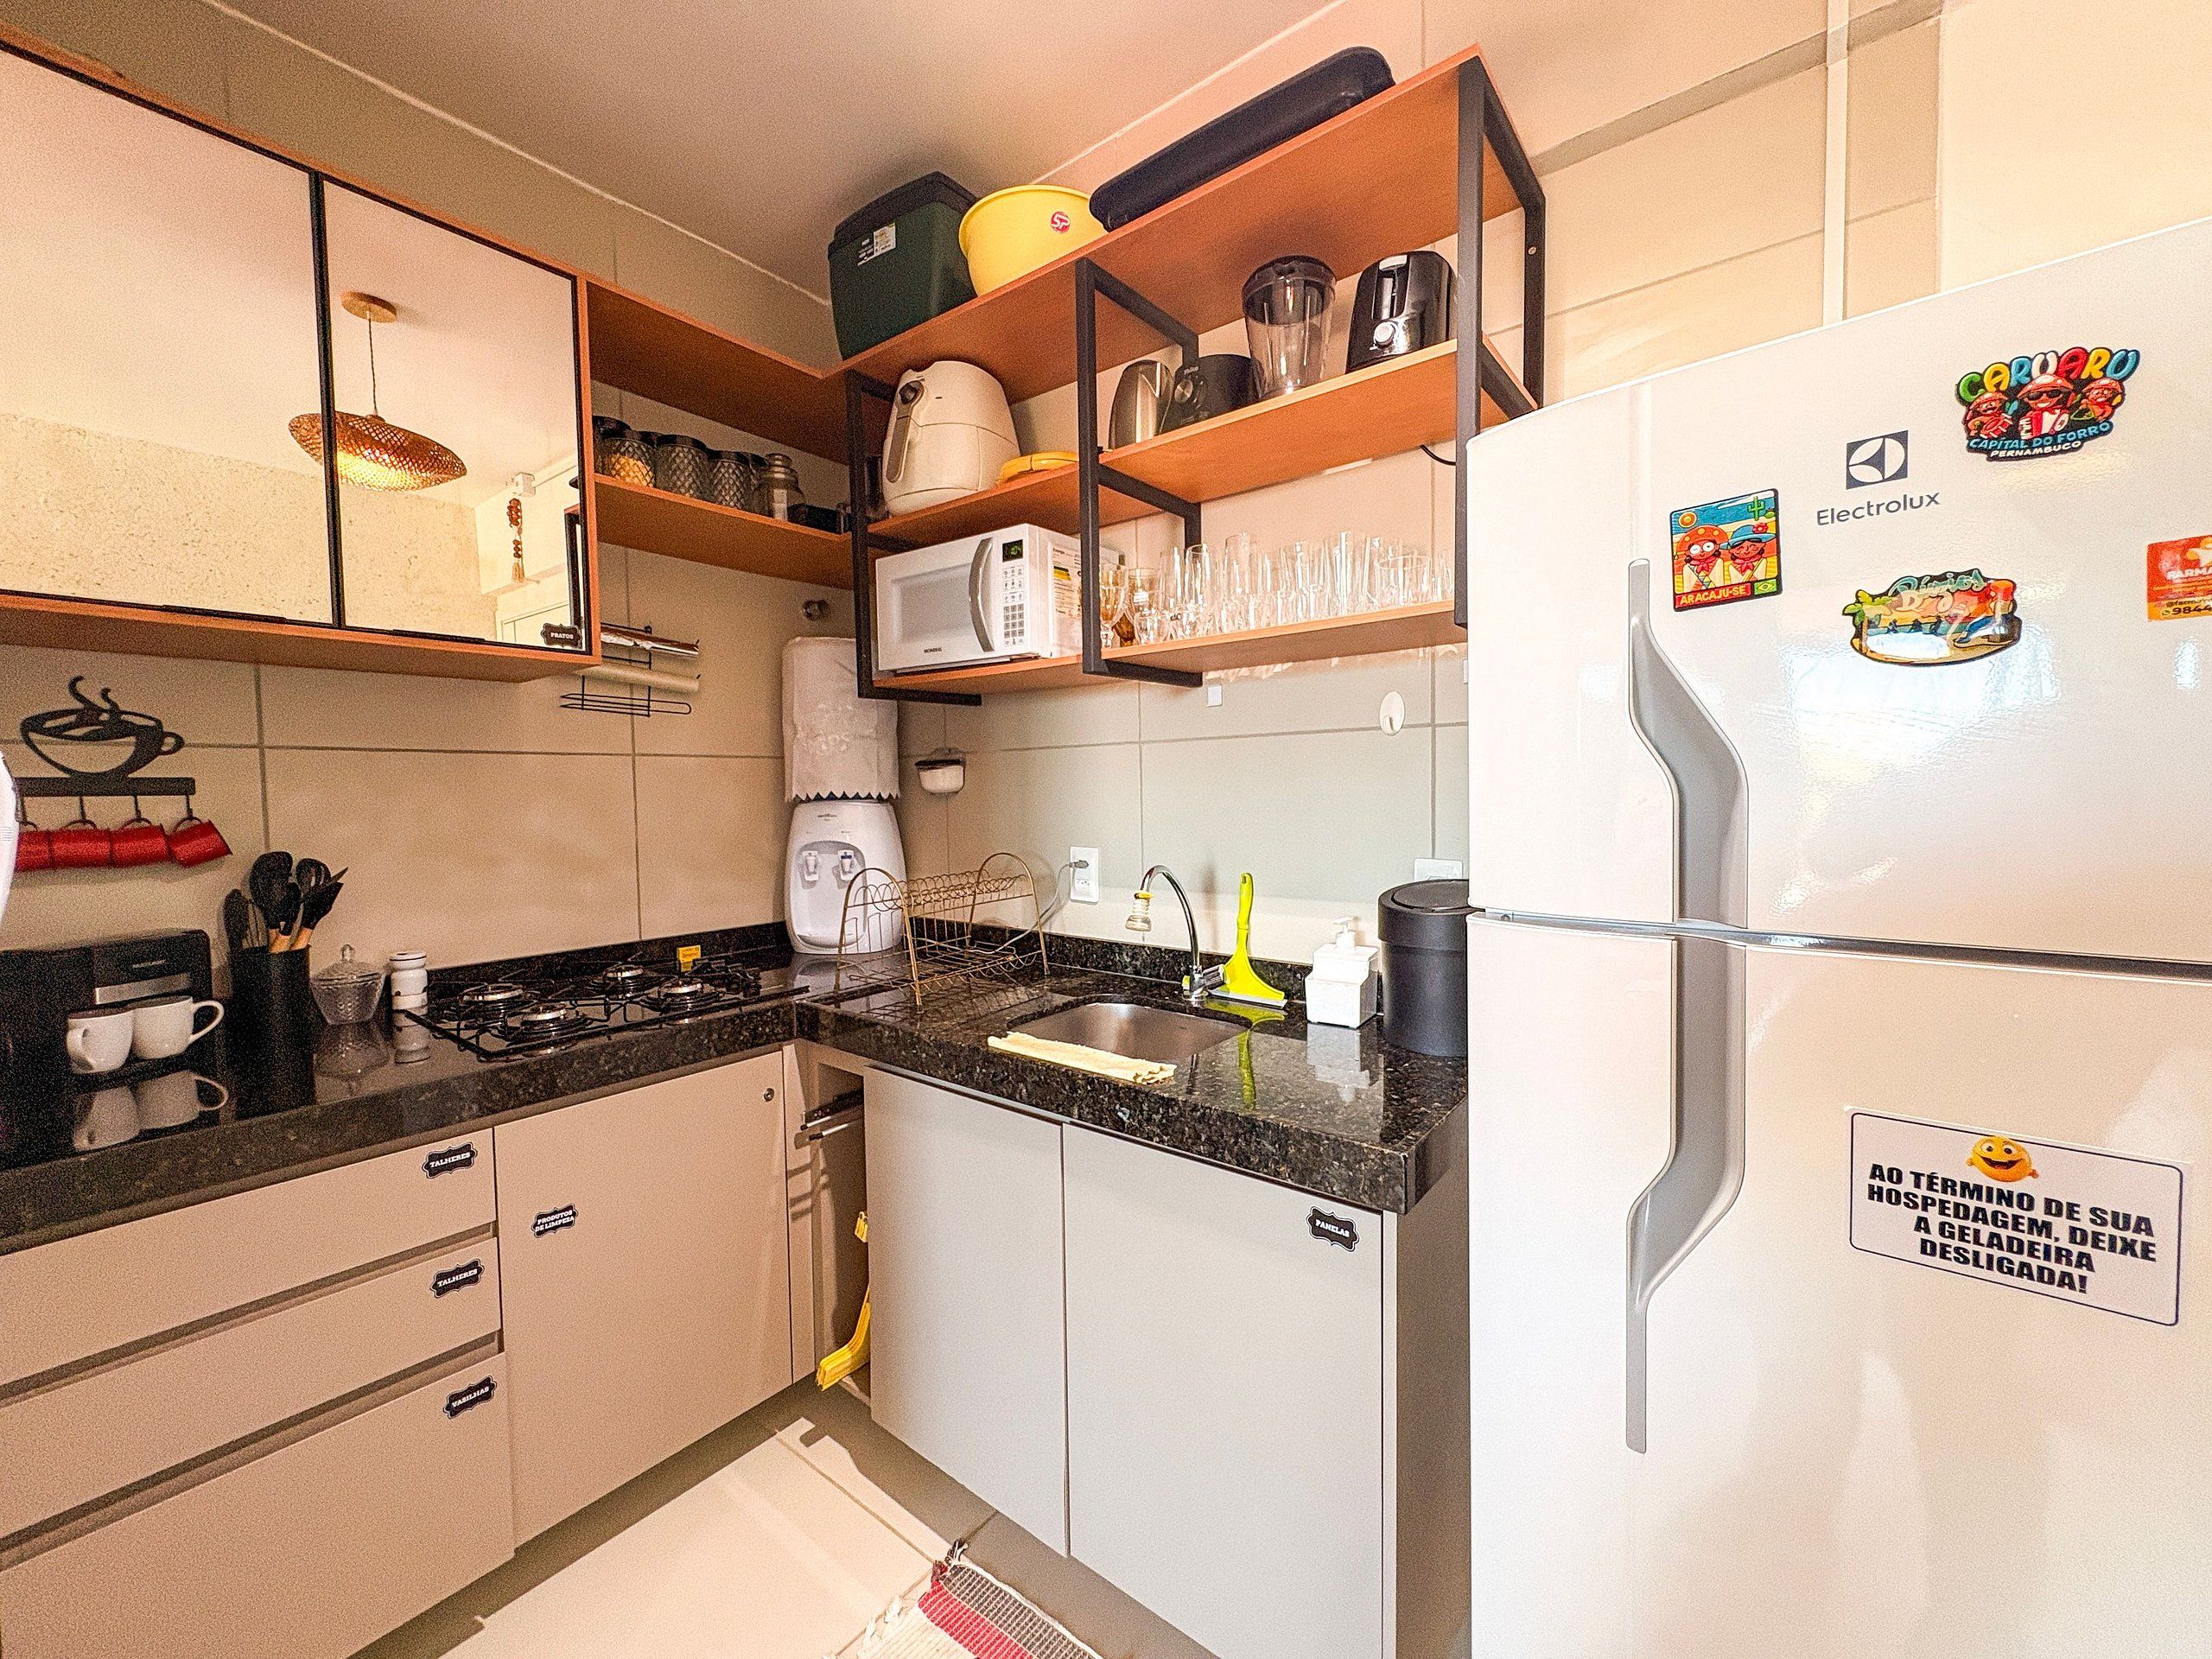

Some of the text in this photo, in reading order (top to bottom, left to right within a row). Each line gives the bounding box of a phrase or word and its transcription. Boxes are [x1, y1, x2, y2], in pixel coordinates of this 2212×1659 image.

[1959, 346, 2138, 402] CARUARU
[2033, 437, 2053, 447] DO
[2057, 423, 2111, 442] FORRO
[1990, 441, 2082, 457] PERNAMBUCO
[1816, 493, 1941, 525] Electrolux
[1680, 586, 1747, 604] ARACAJU-SE
[429, 1152, 471, 1167] TALHERES
[1869, 1163, 2154, 1237] AO TÉRMINO DE SUA
[537, 1210, 573, 1225] PRODUTOS
[544, 1216, 575, 1229] LIMPEZA
[1315, 1218, 1350, 1238] PANELAS
[1868, 1184, 2156, 1262] HOSPEDAGEM, DEIXE
[1914, 1215, 2095, 1273] A GELADEIRA
[1920, 1237, 2088, 1294] DESLIGADA!
[436, 1268, 478, 1287] TALHERES
[451, 1386, 490, 1408] VASILHAS
